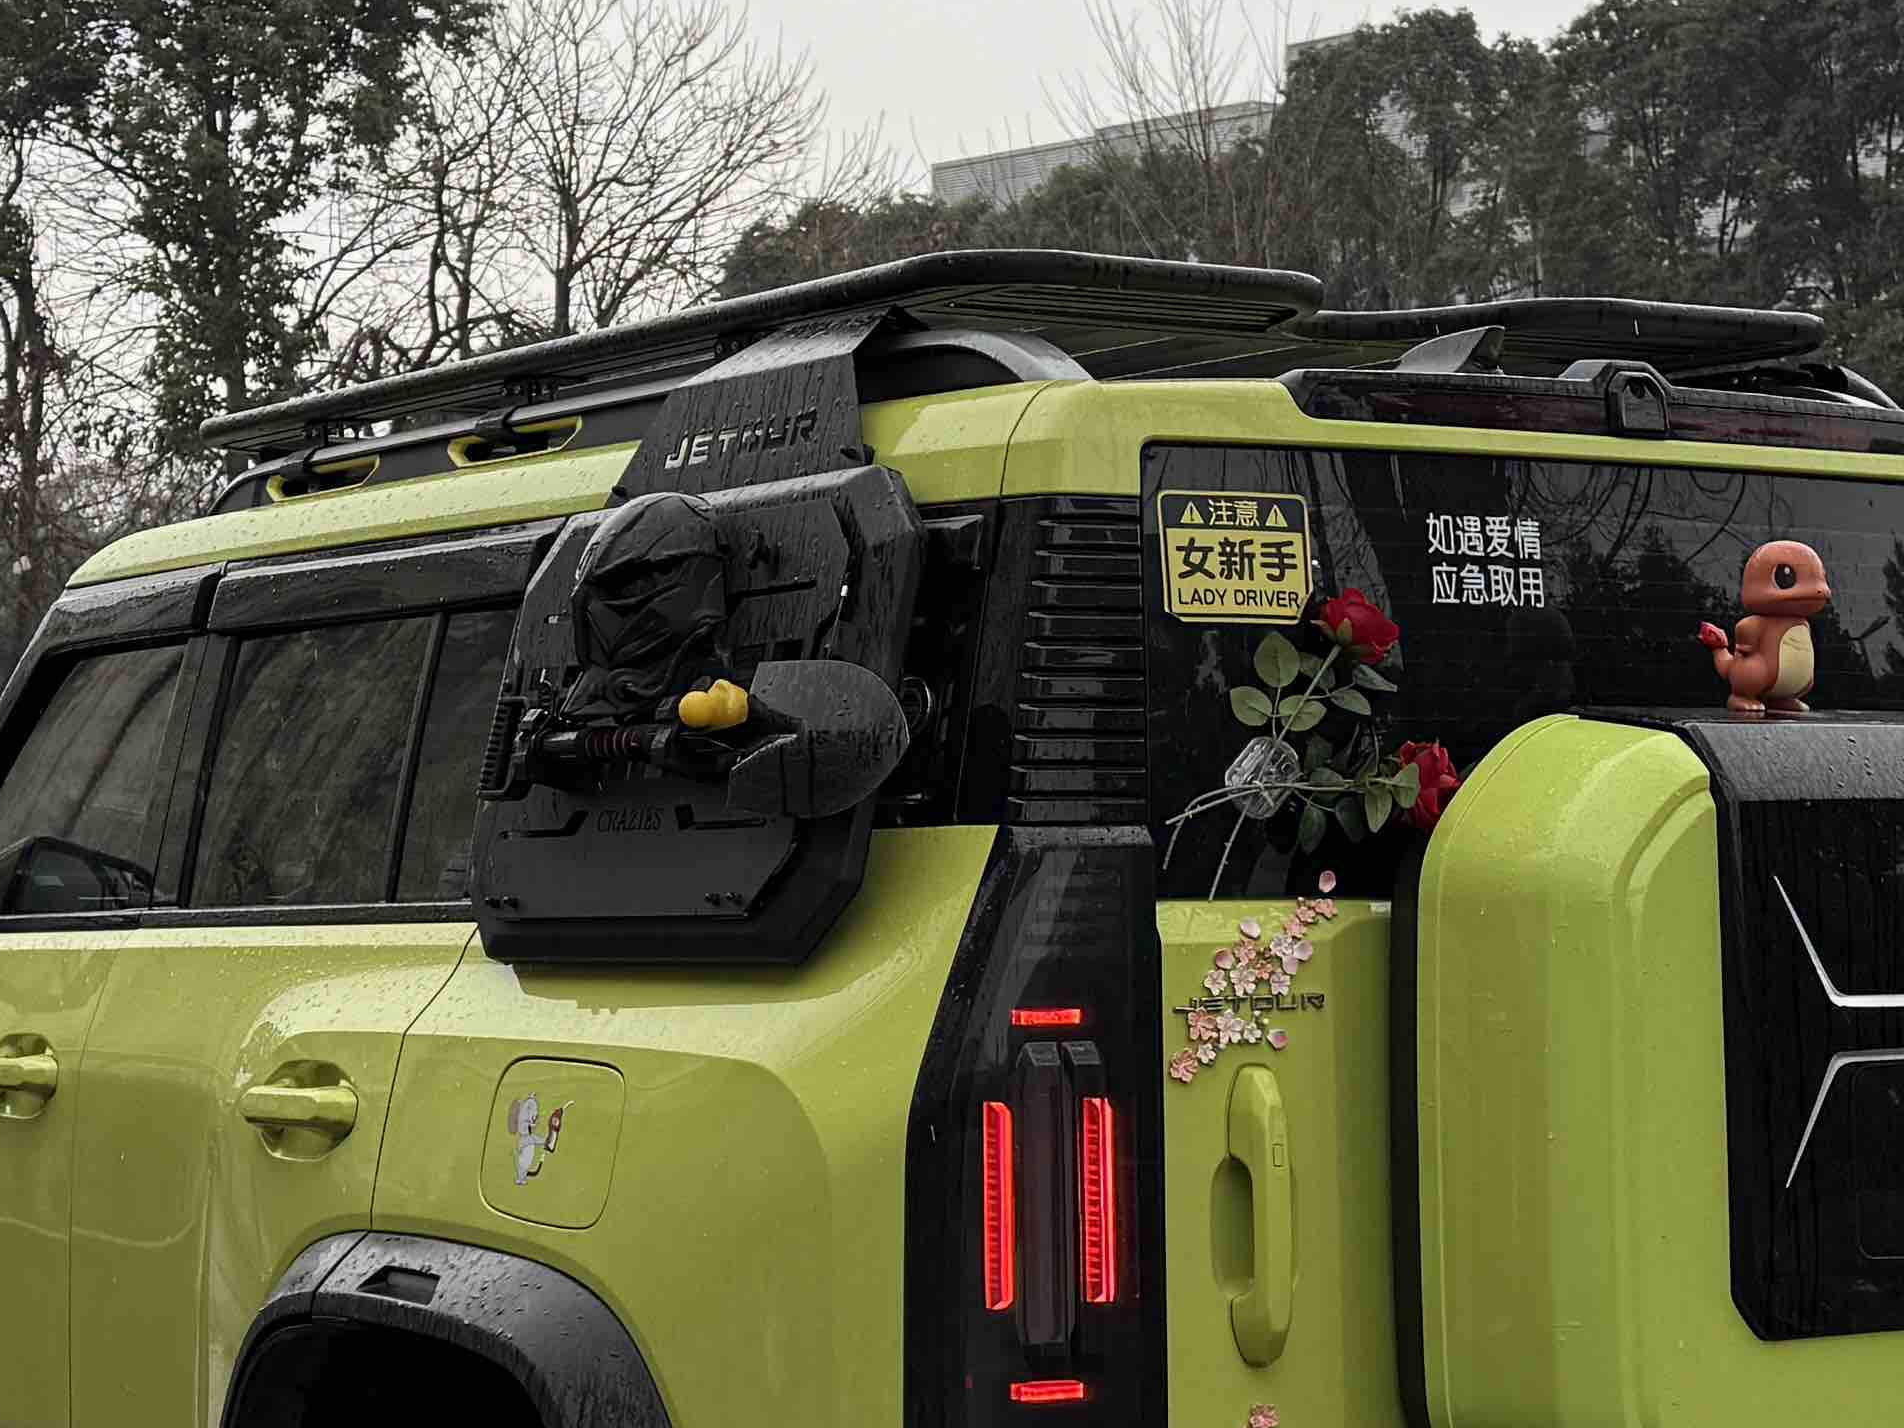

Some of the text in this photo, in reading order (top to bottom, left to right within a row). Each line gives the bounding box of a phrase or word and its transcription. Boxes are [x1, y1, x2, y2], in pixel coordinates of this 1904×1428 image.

[664, 406, 817, 469] JETOUR
[1208, 499, 1259, 527] 注意
[1426, 512, 1541, 560] 如遇爱情
[1175, 536, 1299, 582] 女新手
[1178, 587, 1301, 609] LADY DRIVER
[1432, 562, 1544, 608] 应急取用
[1172, 992, 1325, 1013] JETOUR
